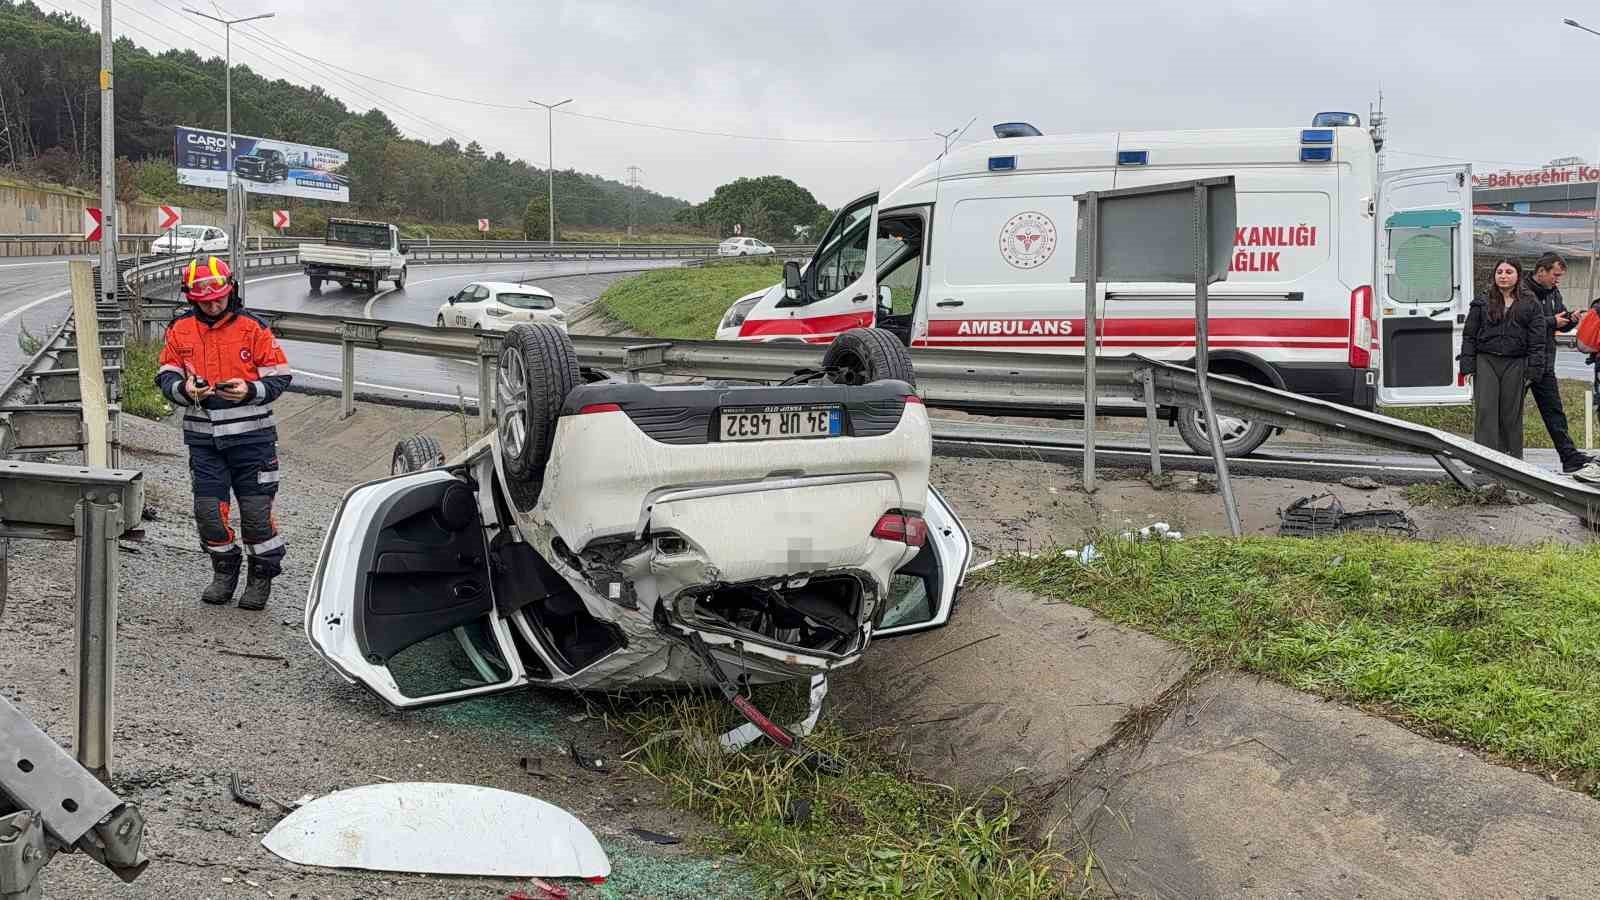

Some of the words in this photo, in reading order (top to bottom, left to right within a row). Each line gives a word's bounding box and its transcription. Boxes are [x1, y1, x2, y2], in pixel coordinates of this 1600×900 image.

[1232, 223, 1317, 247] KANLIĞI
[958, 320, 1073, 335] AMBULANS
[727, 413, 771, 437] 4632
[780, 412, 801, 437] UR
[807, 411, 828, 433] 34
